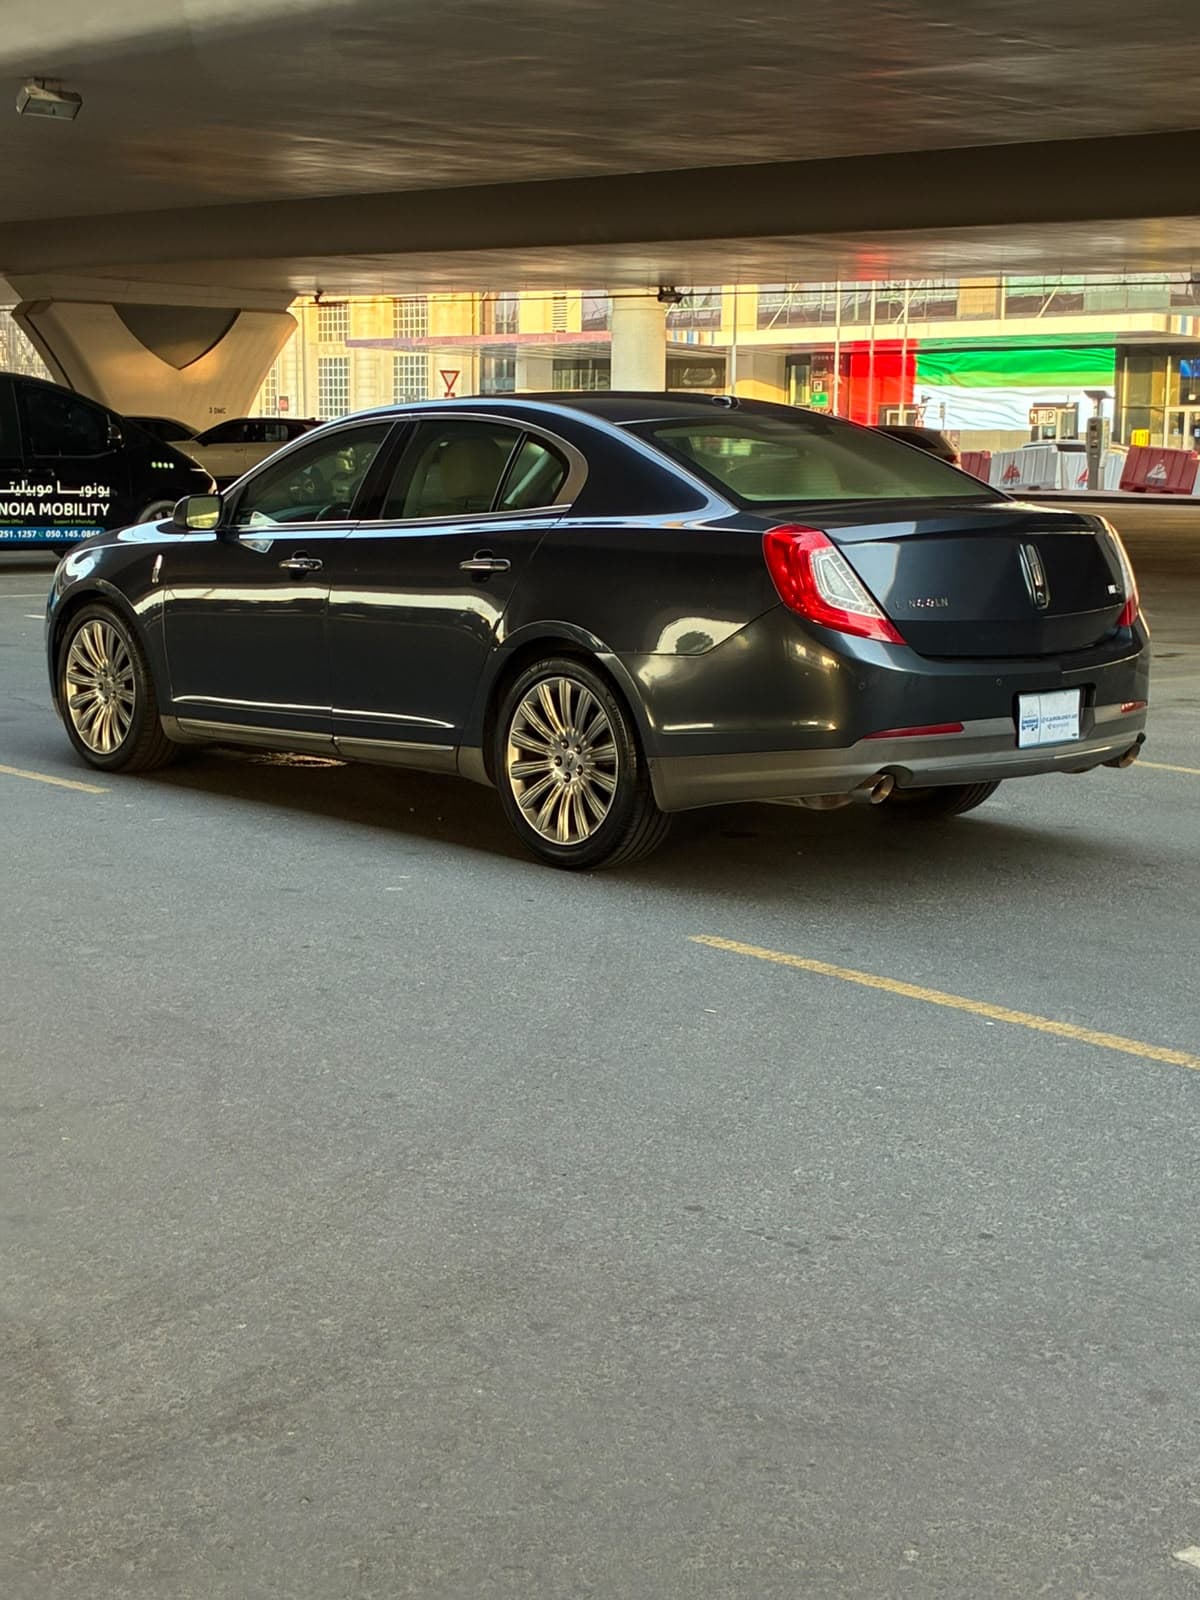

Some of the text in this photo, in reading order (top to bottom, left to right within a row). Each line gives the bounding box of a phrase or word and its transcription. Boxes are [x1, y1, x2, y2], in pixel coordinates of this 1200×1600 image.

[57, 480, 110, 498] يونويا
[39, 502, 110, 516] MOBILITY
[896, 598, 948, 609] LNCOLN
